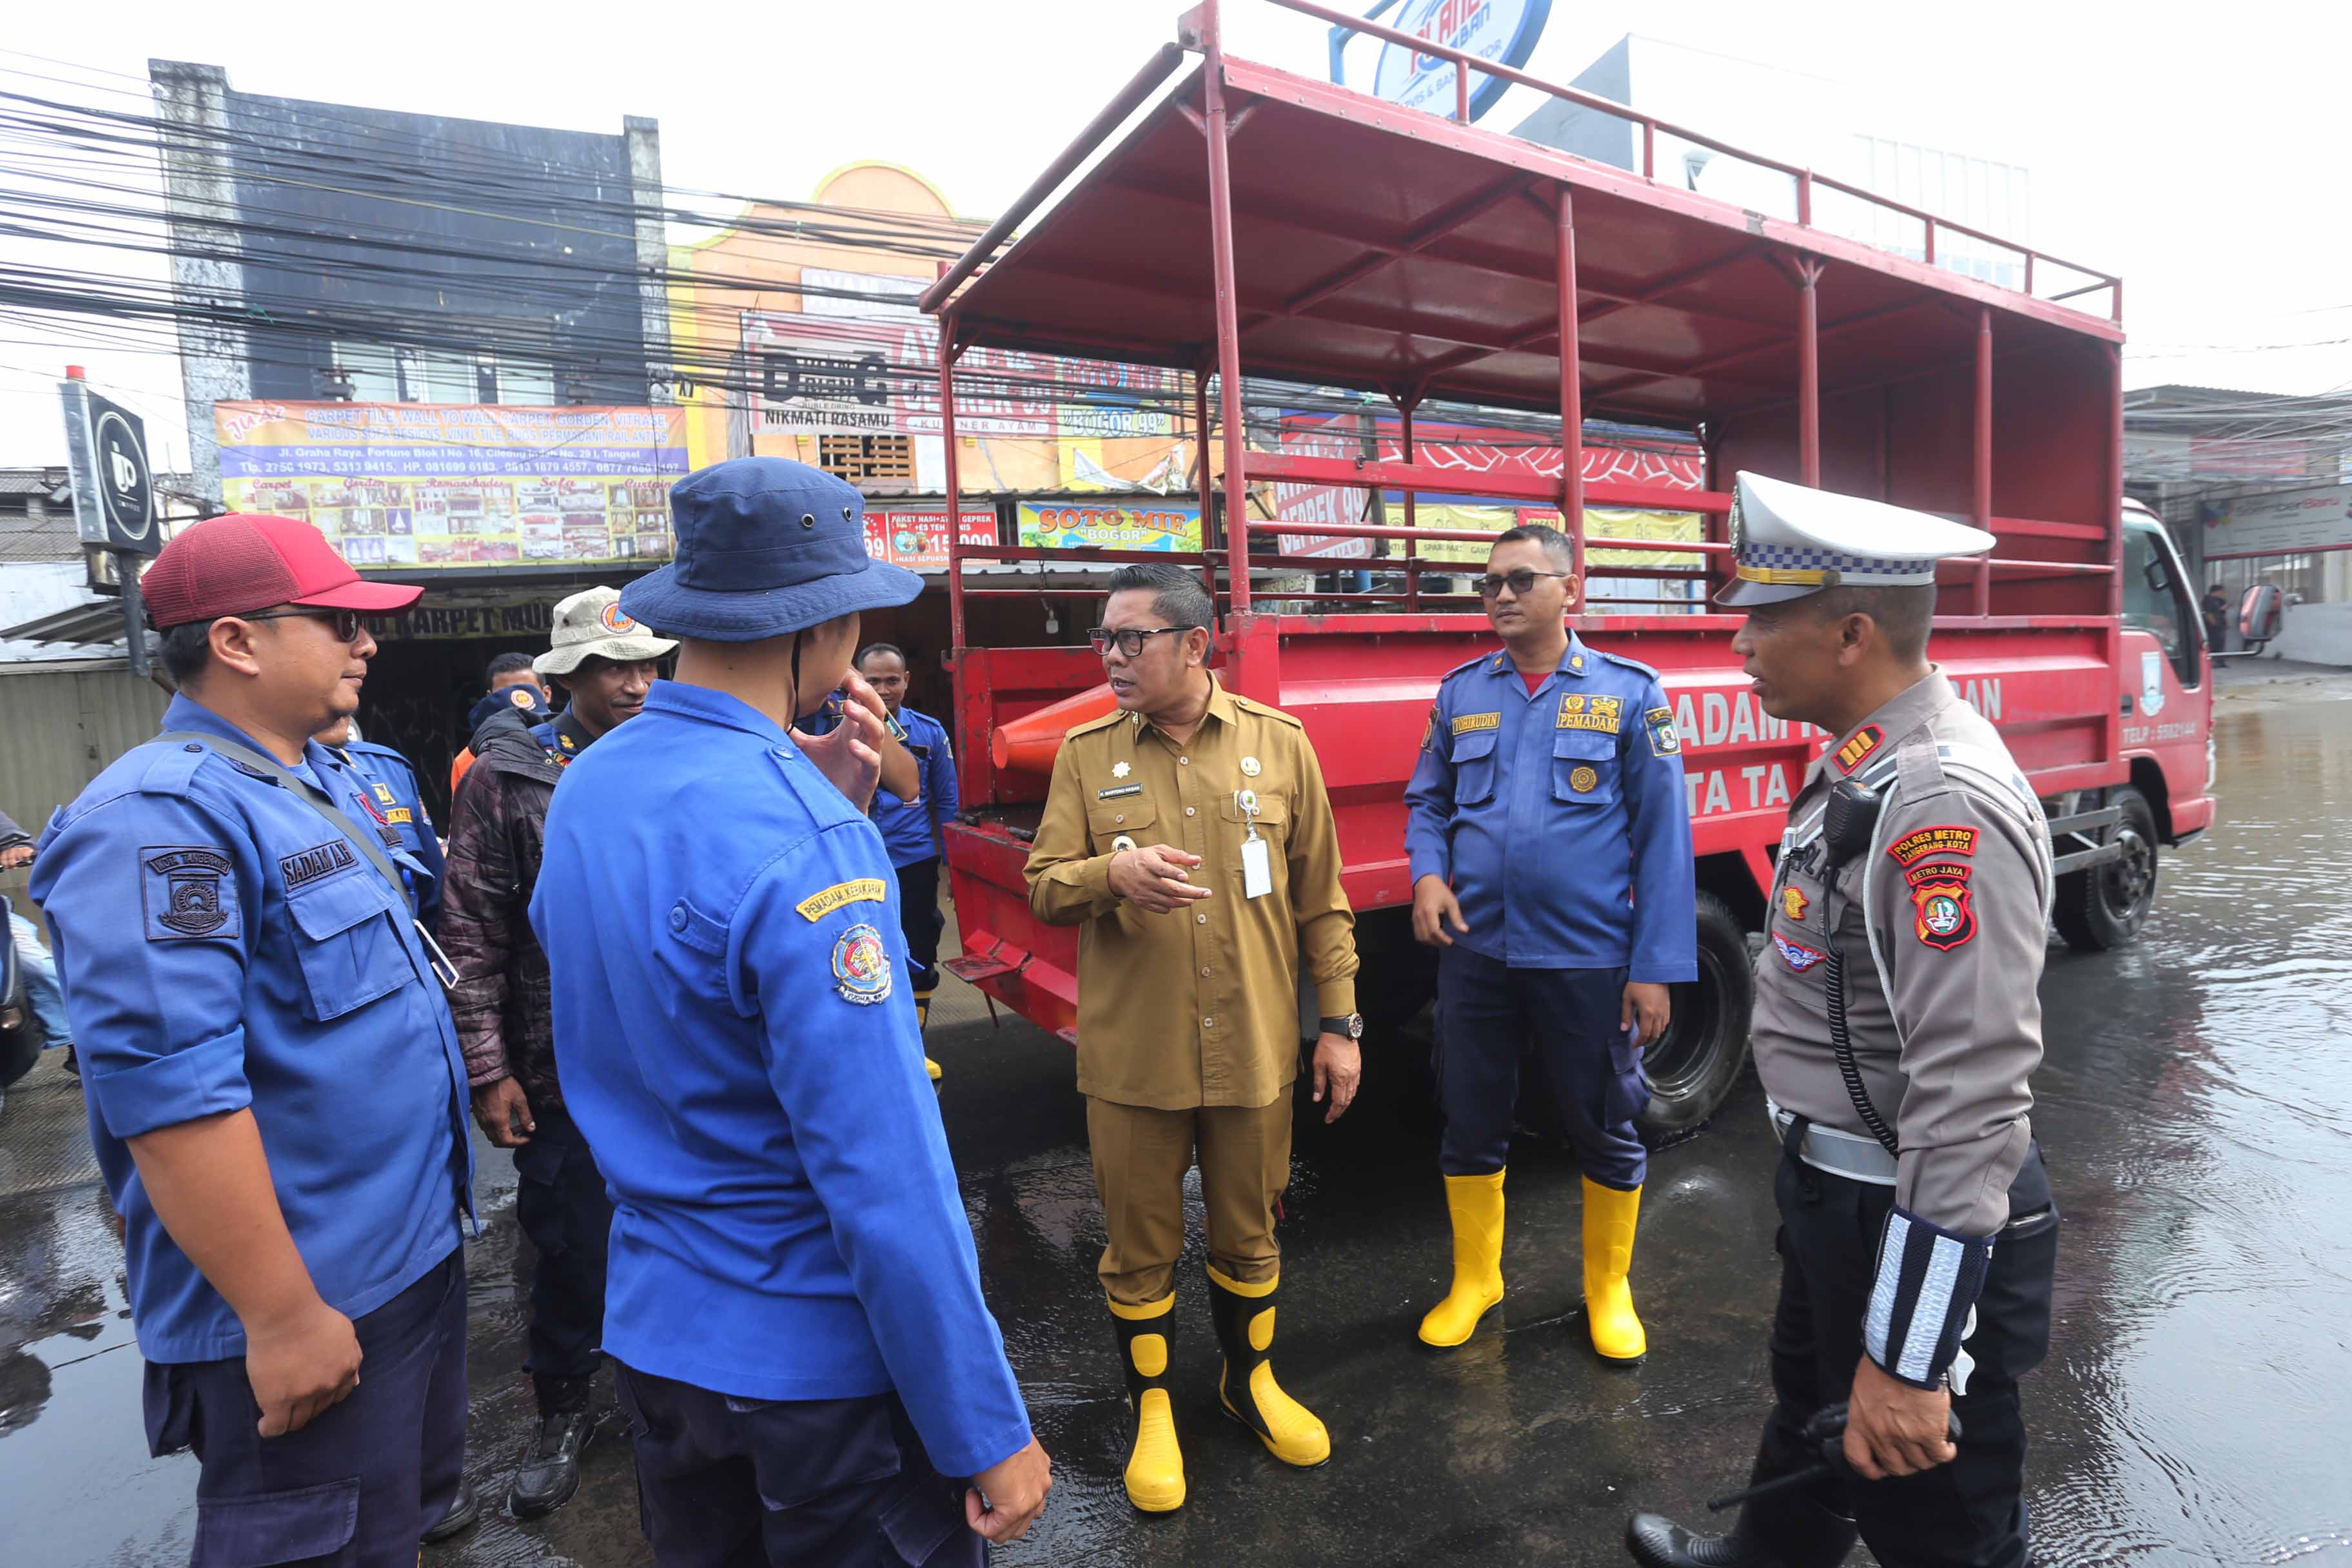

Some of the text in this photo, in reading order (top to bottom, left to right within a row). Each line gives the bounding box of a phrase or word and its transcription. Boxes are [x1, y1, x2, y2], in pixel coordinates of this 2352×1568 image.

[1460, 3, 1491, 46] BAN
[306, 409, 362, 424] CARPET
[366, 409, 397, 424] TILE,
[401, 410, 438, 424] WALL
[441, 411, 460, 423] TO
[462, 411, 496, 424] WALL
[501, 413, 555, 427] CARPET,
[765, 409, 890, 427] NIKMATI RASAMU
[921, 419, 1037, 431] KUNER AYAM
[308, 428, 358, 440] VARIOUS
[446, 429, 478, 441] VINYL
[507, 429, 537, 442] RUGS
[279, 448, 293, 457] Jl.
[296, 448, 331, 457] Graha
[368, 448, 411, 457] Fortune
[413, 449, 438, 457] Blok
[447, 449, 465, 458] No.
[404, 463, 422, 473] HP.
[252, 479, 293, 491] Carpet
[541, 477, 575, 495] Sofa
[625, 478, 672, 489] Curtain
[892, 515, 916, 524] PAKET
[1039, 507, 1187, 536] SOTO MIE
[1080, 529, 1148, 541] "BOGOR"
[1453, 716, 1497, 732] TOHIRUDIN
[1559, 714, 1617, 730] PEMADAM
[1676, 691, 1788, 747] ADAM
[2122, 727, 2149, 743] TELP
[1894, 829, 1972, 856] POLRES METRO
[1901, 839, 1969, 862] TANGERANG-KOTA
[155, 858, 179, 868] KOTA
[282, 847, 335, 886] SADAM
[1912, 867, 1963, 881] METRO JAYA
[804, 892, 843, 916] PEMADAM
